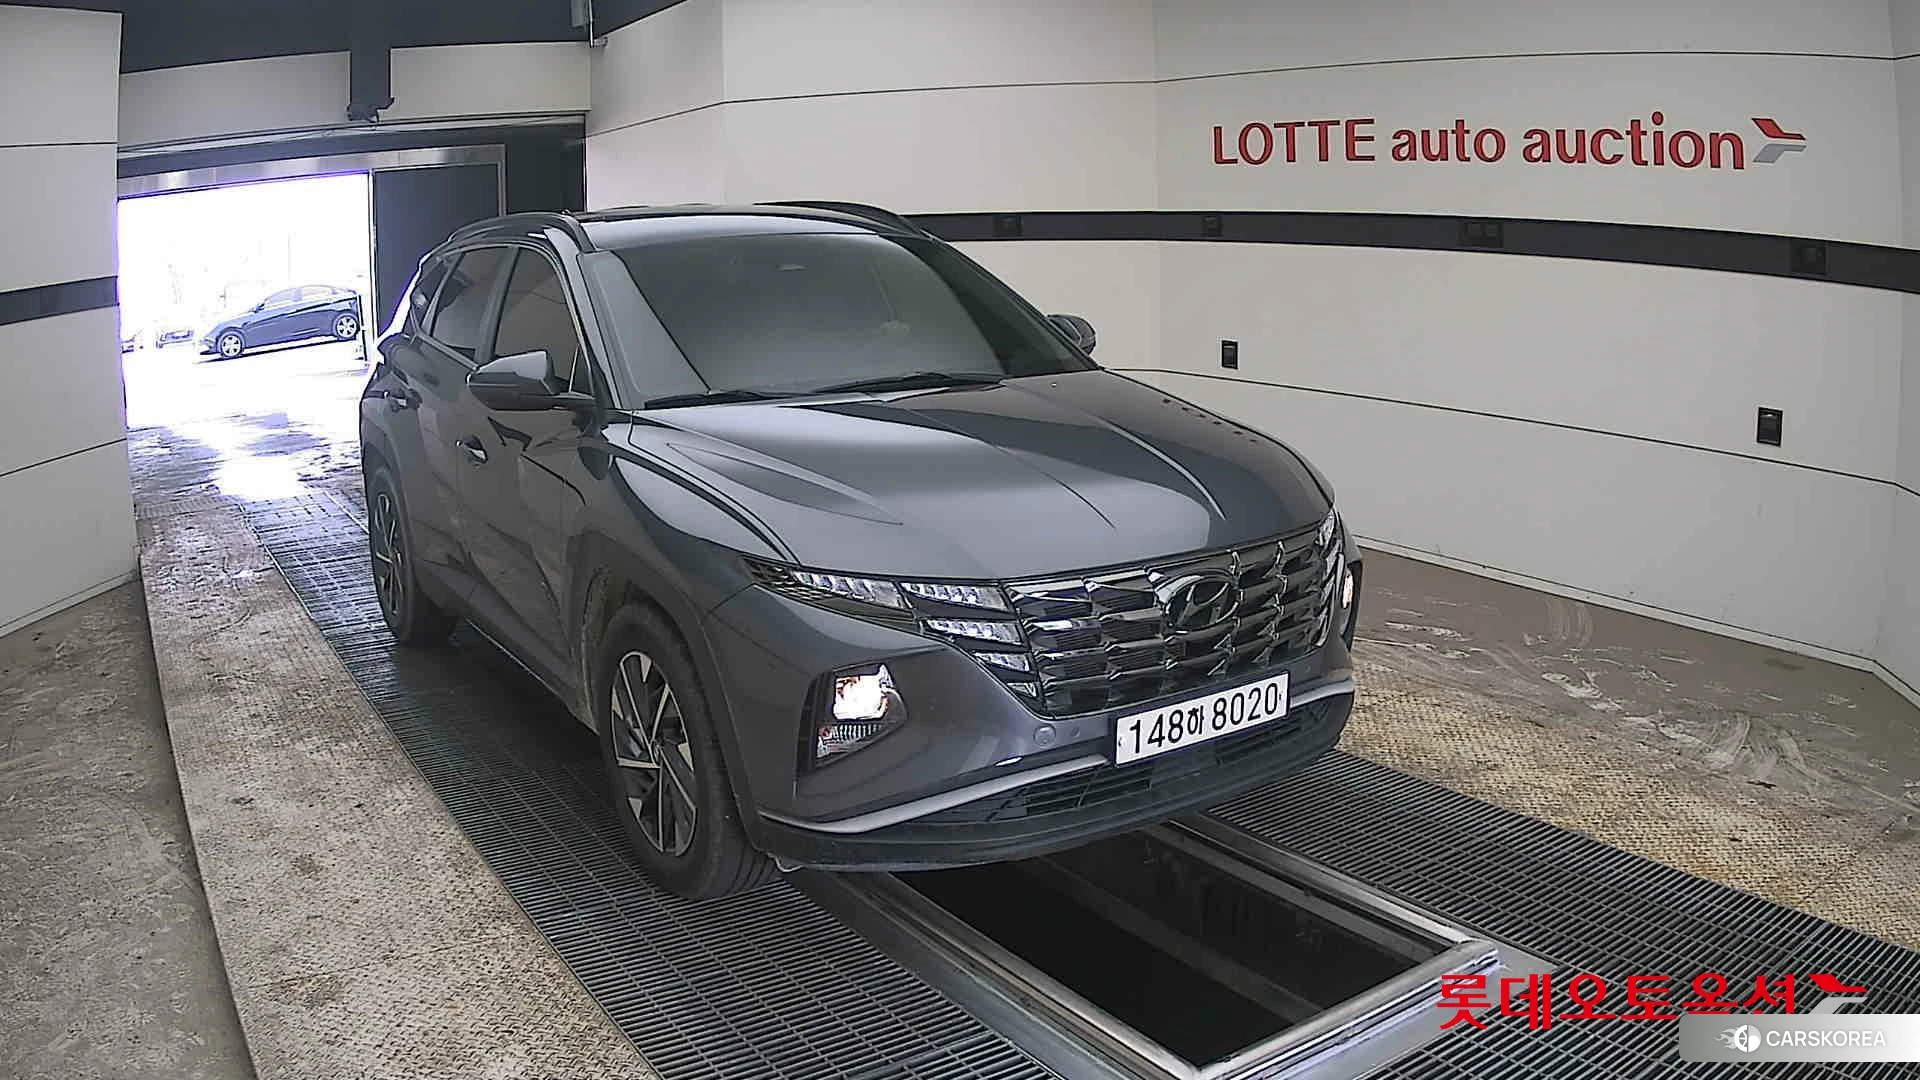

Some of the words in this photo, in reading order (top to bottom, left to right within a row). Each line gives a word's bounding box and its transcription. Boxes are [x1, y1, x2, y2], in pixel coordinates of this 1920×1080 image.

[1212, 118, 1376, 166] LOTTE
[1391, 119, 1506, 162] auto
[1522, 111, 1745, 170] auction
[1211, 682, 1279, 731] 8020
